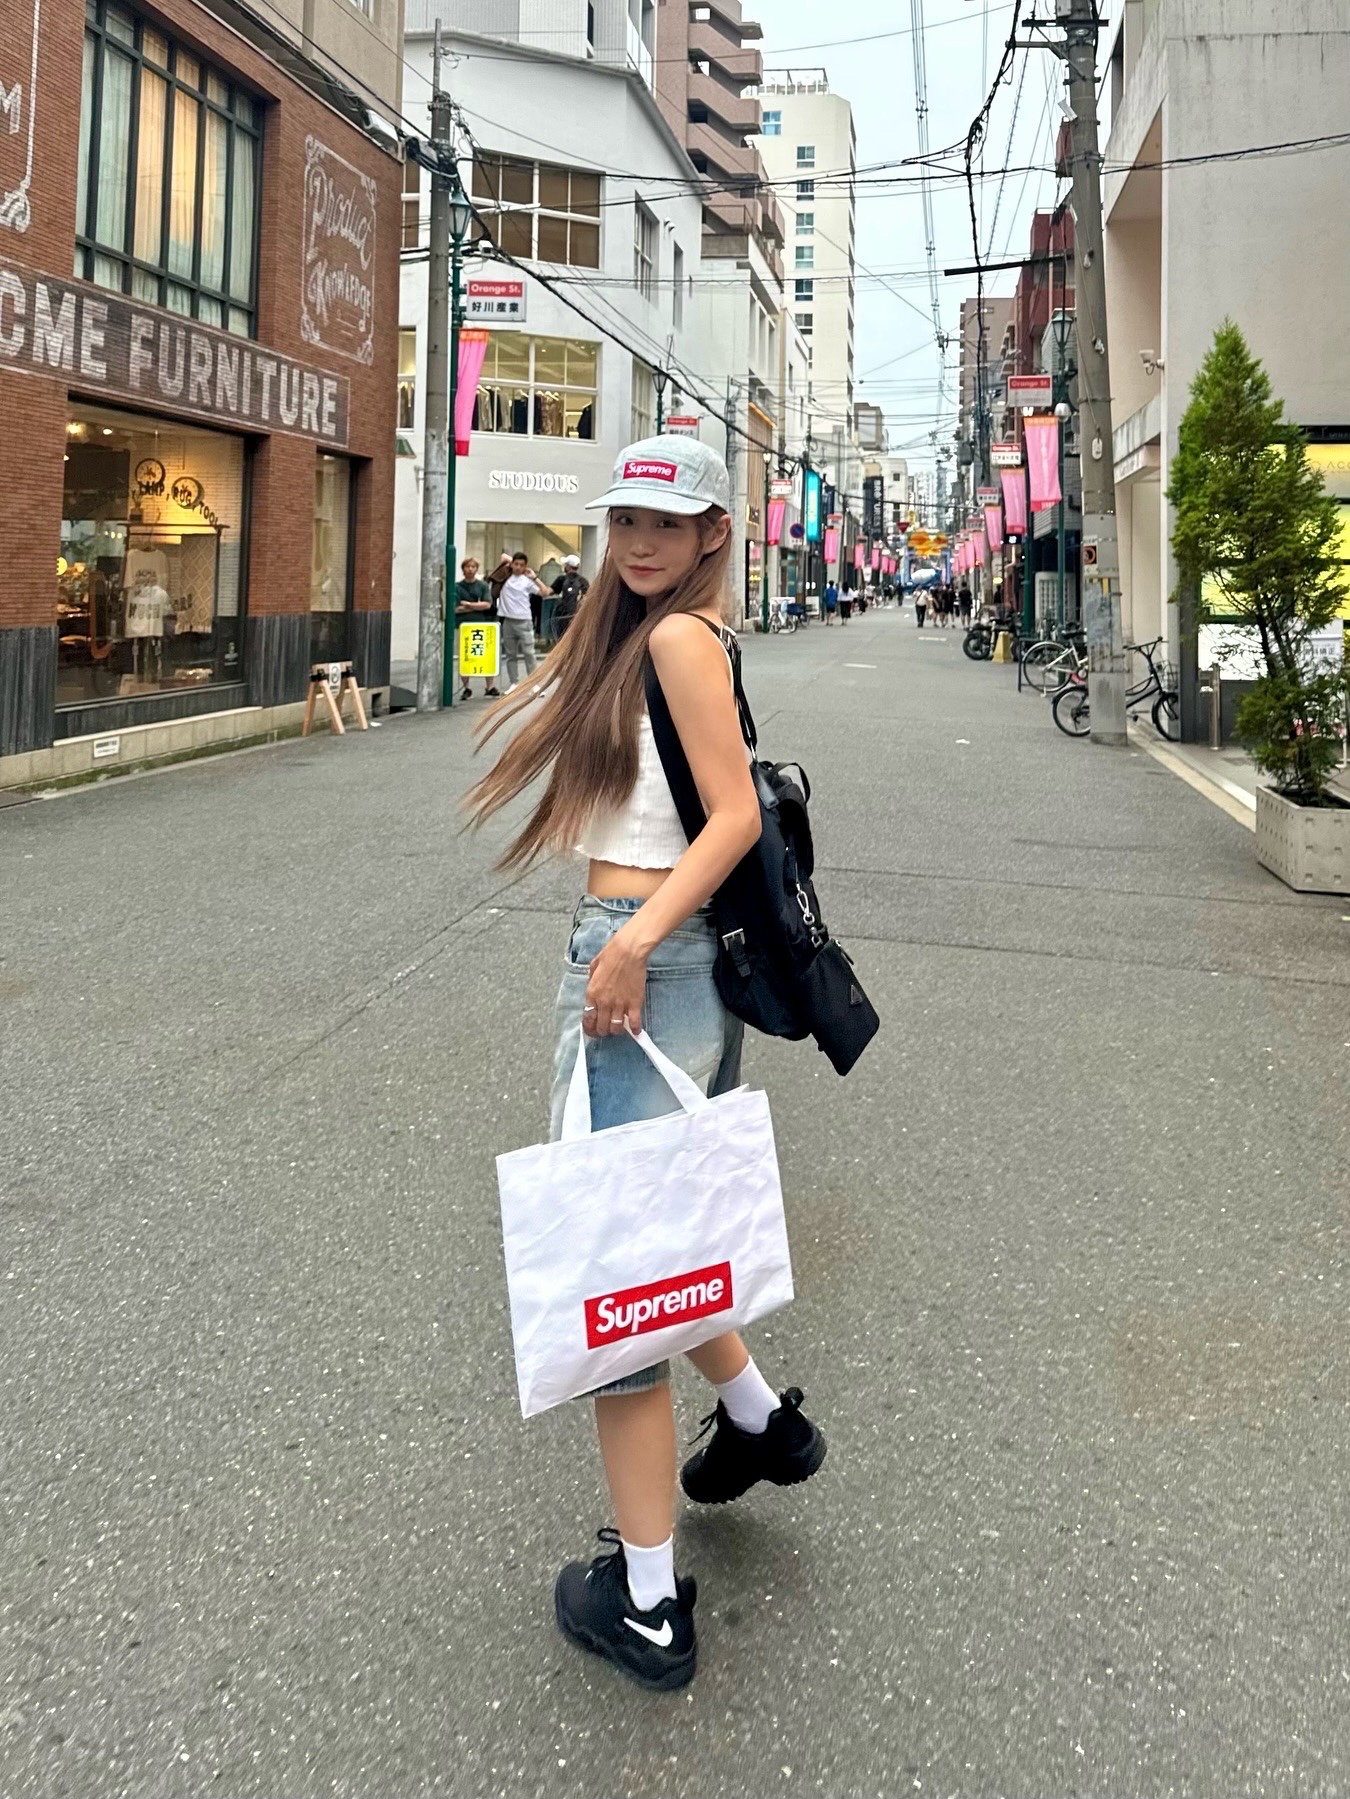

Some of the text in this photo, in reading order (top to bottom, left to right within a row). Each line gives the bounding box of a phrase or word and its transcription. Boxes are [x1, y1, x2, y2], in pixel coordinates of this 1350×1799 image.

[471, 283, 521, 295] Orange St.
[472, 302, 519, 312] 好川産業
[129, 314, 337, 436] FURNITURE
[1011, 380, 1038, 388] Orange
[627, 462, 672, 476] Supreme
[489, 470, 579, 493] STUDIOUS
[596, 1277, 725, 1334] Supreme
